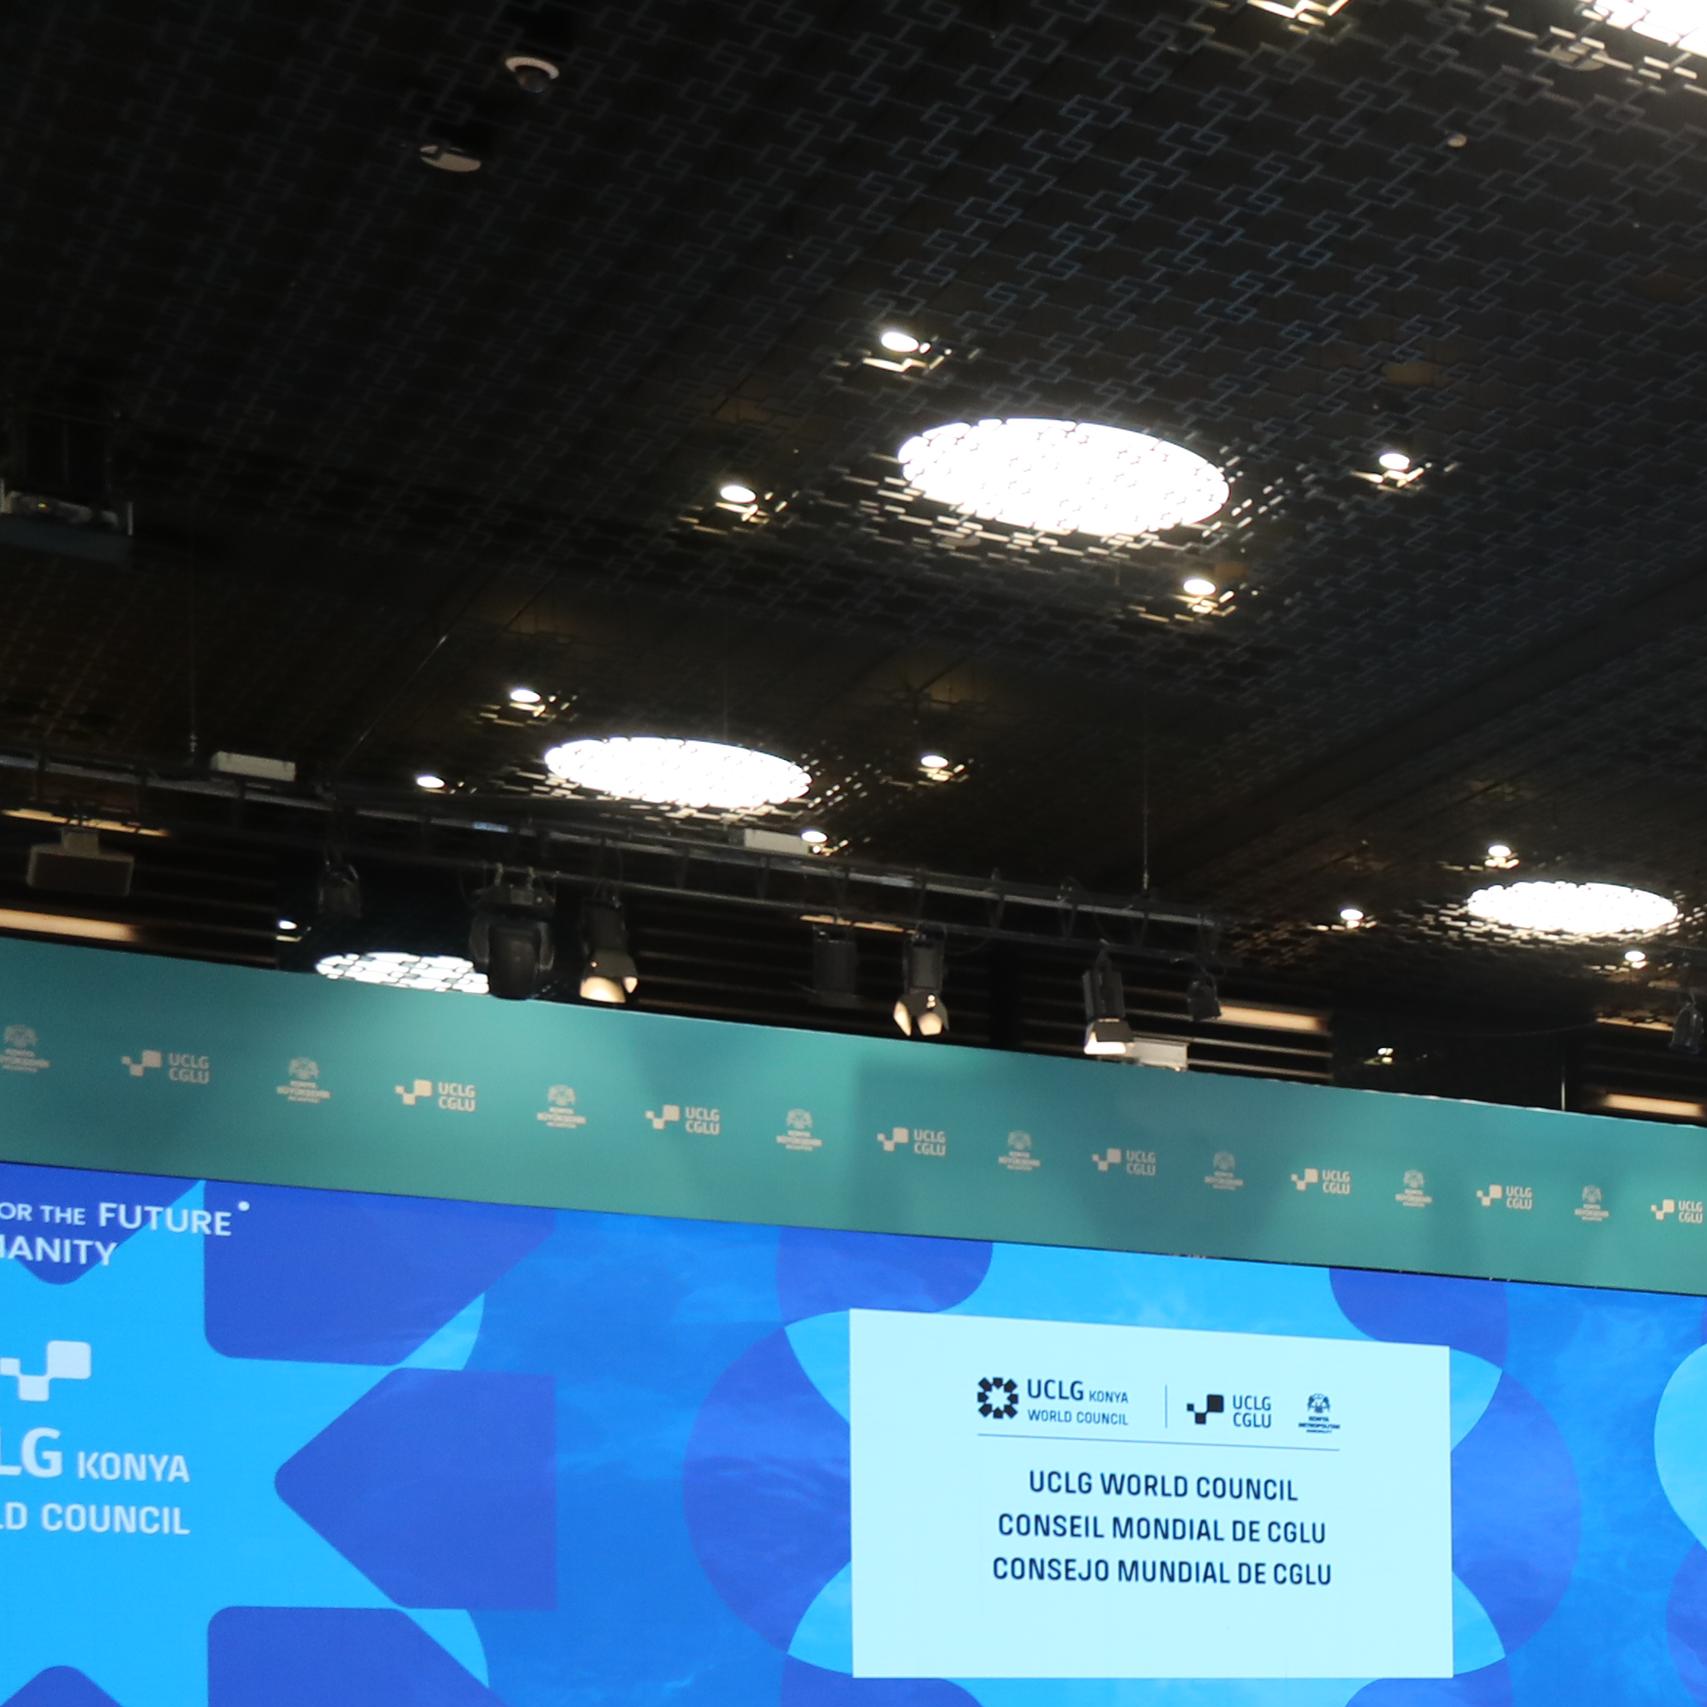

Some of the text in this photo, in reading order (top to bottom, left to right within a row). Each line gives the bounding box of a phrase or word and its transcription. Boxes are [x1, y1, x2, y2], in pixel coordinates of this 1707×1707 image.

[169, 1052, 209, 1069] UCLG
[169, 1068, 209, 1084] CGLU
[438, 1082, 475, 1098] UCLG
[438, 1096, 475, 1112] CGLU
[685, 1107, 720, 1121] UCLG
[685, 1120, 720, 1135] CGLU
[914, 1129, 946, 1144] UCLG
[914, 1142, 946, 1156] CGLU
[1322, 1169, 1350, 1182] UCLG
[1322, 1182, 1350, 1195] CGLU
[1506, 1185, 1533, 1198] UCLG
[1506, 1197, 1533, 1210] CGLU
[1678, 1200, 1703, 1212] UCLG
[0, 1202, 232, 1237] OR THE FUTURE
[1678, 1211, 1703, 1224] CGLU
[0, 1233, 117, 1266] ANITY
[1027, 1379, 1129, 1404] UCLG KONYA
[1232, 1394, 1272, 1411] UCLG
[1027, 1409, 1129, 1427] WORLD COUNCIL
[1232, 1412, 1272, 1429] CGLU
[77, 1451, 190, 1483] KONYA
[1029, 1470, 1298, 1502] UCLG WORLD COUNCIL
[41, 1503, 190, 1535] COUNCIL
[998, 1513, 1326, 1545] CONSEIL MONDIAL DE CGLU
[992, 1557, 1332, 1587] CONSEJO MUNDIAL DE CGLU
